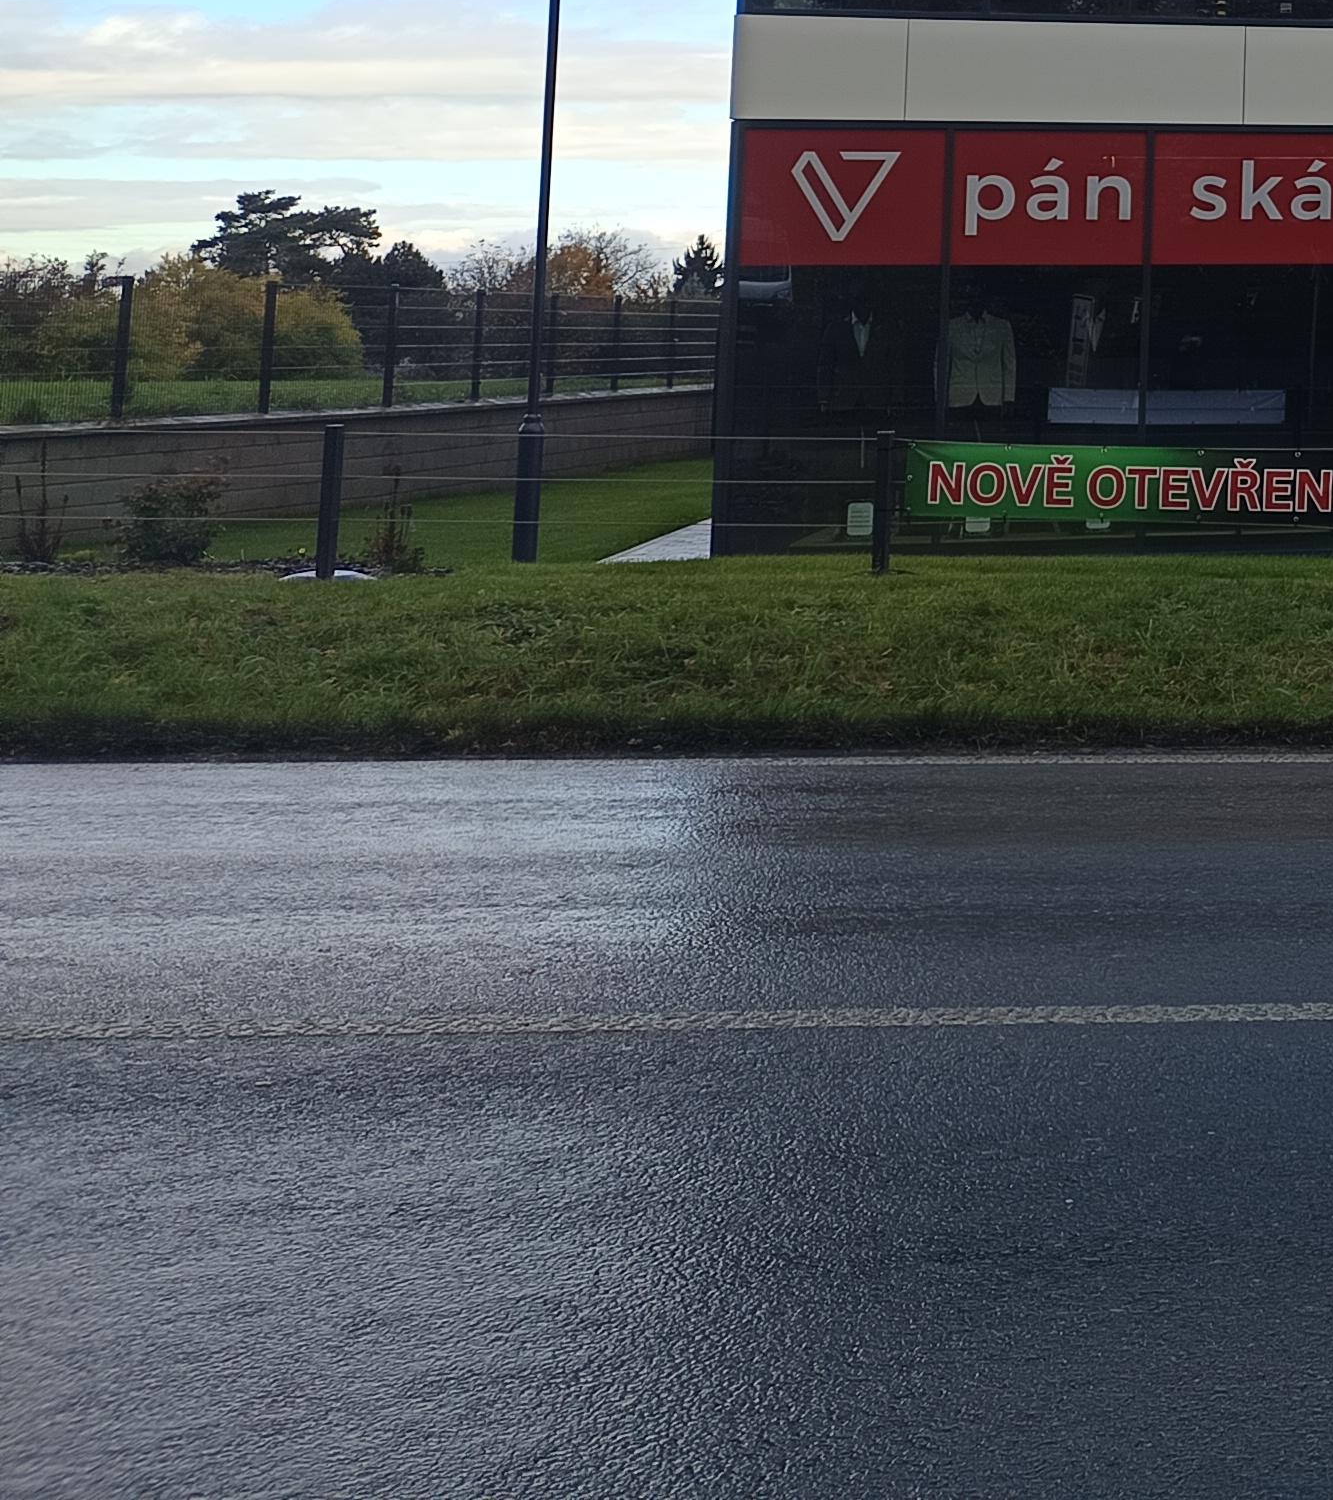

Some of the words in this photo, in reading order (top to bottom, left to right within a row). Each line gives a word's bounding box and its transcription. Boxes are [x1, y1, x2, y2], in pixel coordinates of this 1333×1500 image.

[964, 157, 1132, 236] pán
[1189, 159, 1333, 221] ská
[927, 455, 1075, 508] NOVĚ
